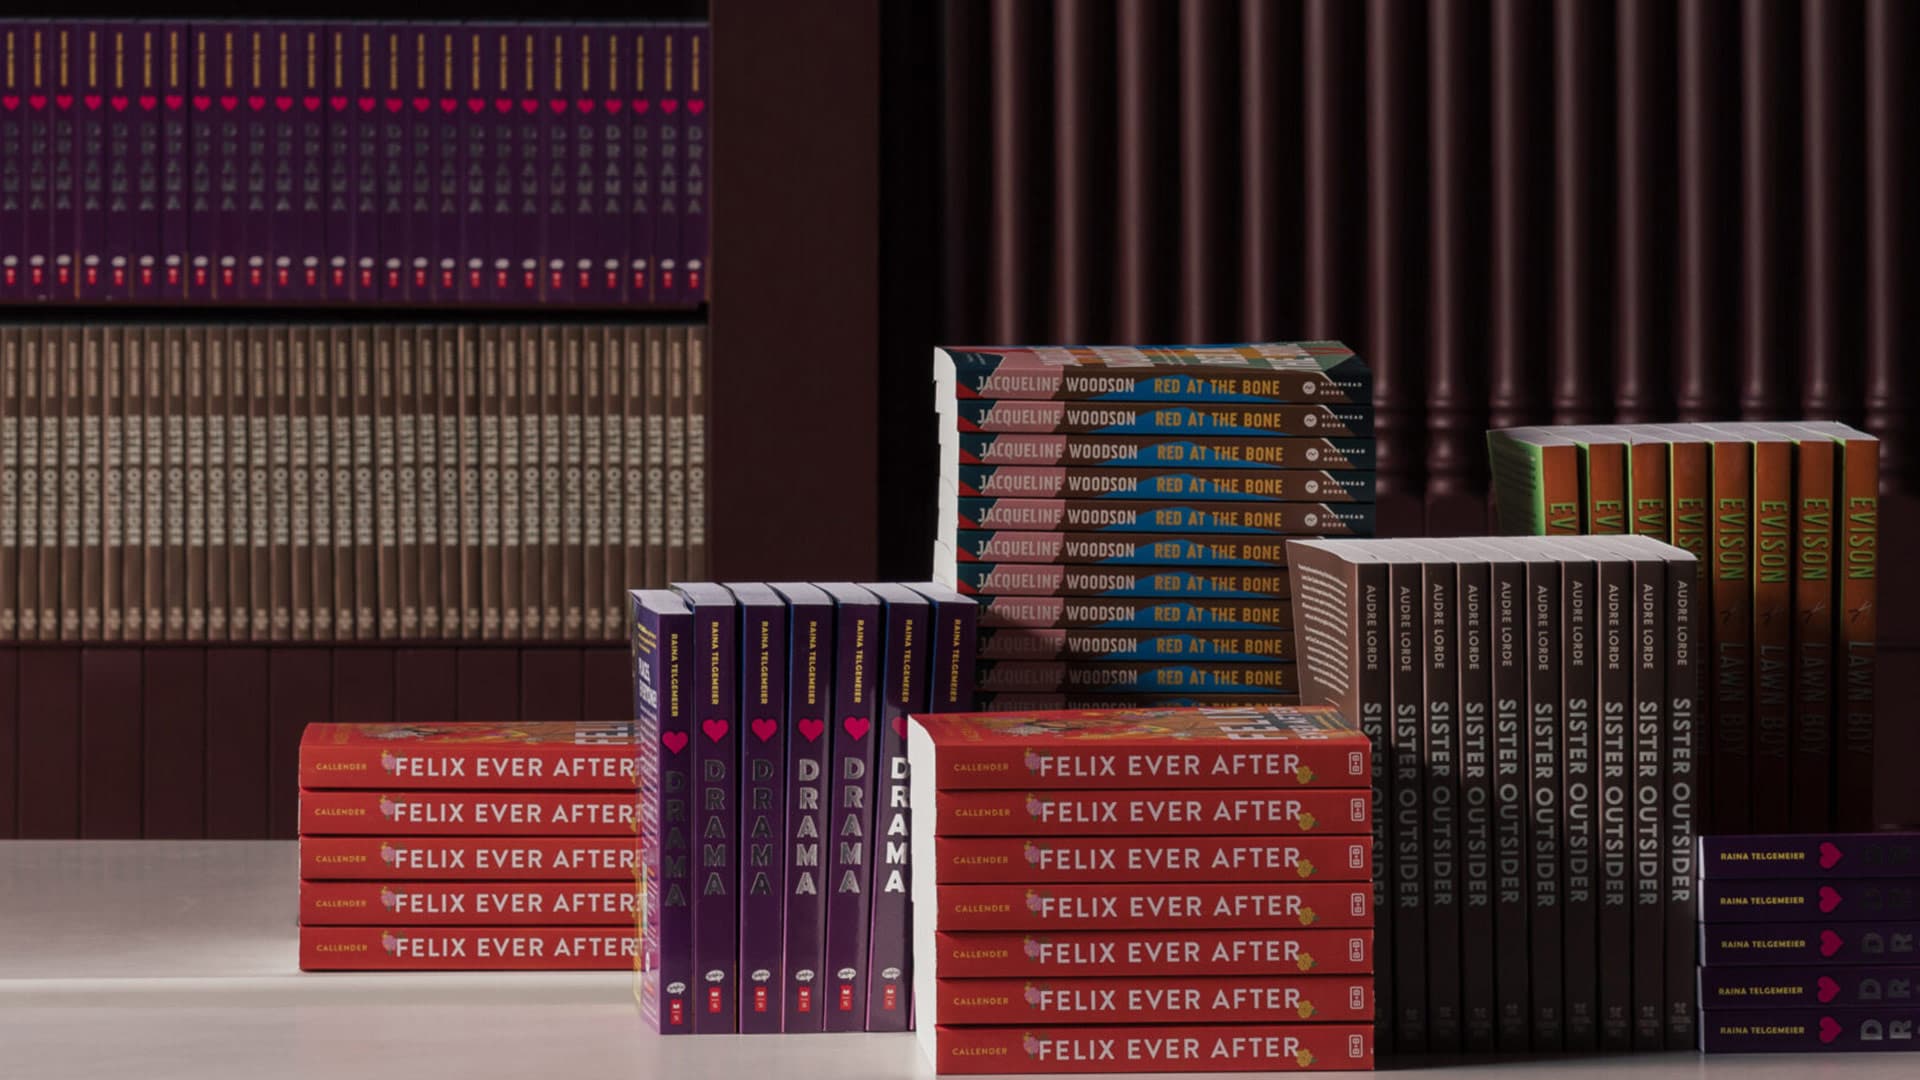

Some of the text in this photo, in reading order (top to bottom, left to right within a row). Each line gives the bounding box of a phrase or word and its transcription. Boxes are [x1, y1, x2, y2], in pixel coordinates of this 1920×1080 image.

[976, 376, 1280, 396] JACQUELINE WOODSON RED AT THE BONE
[977, 408, 1281, 428] JACQUELINE WOODSON RED AT THE BONE
[978, 474, 1283, 494] JACQUELINE WOODSON RED AT THE BONE
[979, 442, 1283, 462] JACQUELINE WOODSON RED AT THE BONE
[977, 508, 1282, 528] JACQUELINE WOODSON RED AT THE BONE
[1720, 498, 1746, 580] EVISON
[1760, 500, 1786, 584] EVISON
[1801, 498, 1829, 580] EVISON
[1849, 497, 1877, 580] EVISON
[976, 572, 1280, 592] JACQUELINE WOODSON RED AT THE BONE
[1572, 581, 1583, 665] AUDRE LORDE
[1677, 580, 1687, 665] AUDRE LORDE
[808, 621, 817, 704] RAINA TELGEMEIER
[854, 619, 864, 704] RAINA TELGEMEIER
[902, 619, 912, 703] RAINA TELGEMEIER
[950, 619, 961, 702] RAINA TELGEMEIER
[1068, 636, 1137, 653] WOODSON
[1156, 638, 1182, 654] RED
[1188, 638, 1207, 654] AT
[1212, 638, 1238, 654] THE
[1245, 639, 1282, 654] BONE
[1433, 584, 1444, 669] AUDRE LORDE
[1468, 584, 1479, 669] AUDRE LORDE
[1537, 585, 1548, 670] AUDRE LORDE
[1642, 584, 1653, 669] AUDRE LORDE
[1848, 640, 1874, 701] LAWN
[316, 758, 634, 776] CALLENDER FELIX EVER AFTER
[954, 754, 1300, 777] CALLENDER FELIX EVER AFTER
[1431, 701, 1451, 904] SISTER OUTSIDER
[1466, 702, 1486, 906] SISTER OUTSIDER
[1535, 703, 1554, 906] SISTER OUTSIDER
[1568, 698, 1588, 902] SISTER OUTSIDER
[1638, 701, 1658, 904] SISTER OUTSIDER
[1672, 698, 1692, 902] SISTER OUTSIDER
[315, 804, 634, 822] CALLENDER FELIX EVER AFTER
[664, 770, 686, 906] DRAMA
[704, 759, 726, 896] DRAMA
[750, 759, 774, 896] DRAMA
[795, 758, 820, 895] DRAMA
[838, 757, 864, 894] DRAMA
[884, 757, 910, 893] DRAMA
[956, 800, 1302, 823] CALLENDER FELIX EVER AFTER
[316, 848, 634, 868] CALLENDER FELIX EVER AFTER
[1720, 852, 1804, 860] RAINA TELGEMEIER
[954, 894, 1302, 918] CALLENDER FELIX EVER AFTER
[1751, 896, 1804, 904] TELGEMEIER
[317, 938, 636, 958] CALLENDER FELIX EVER AFTER
[952, 940, 1300, 964] CALLENDER FELIX EVER AFTER
[1752, 940, 1806, 948] TELGEMEIER
[952, 1036, 1300, 1061] CALLENDER FELIX EVER AFTER
[1720, 1026, 1804, 1034] RAINA TELGEMEIER
